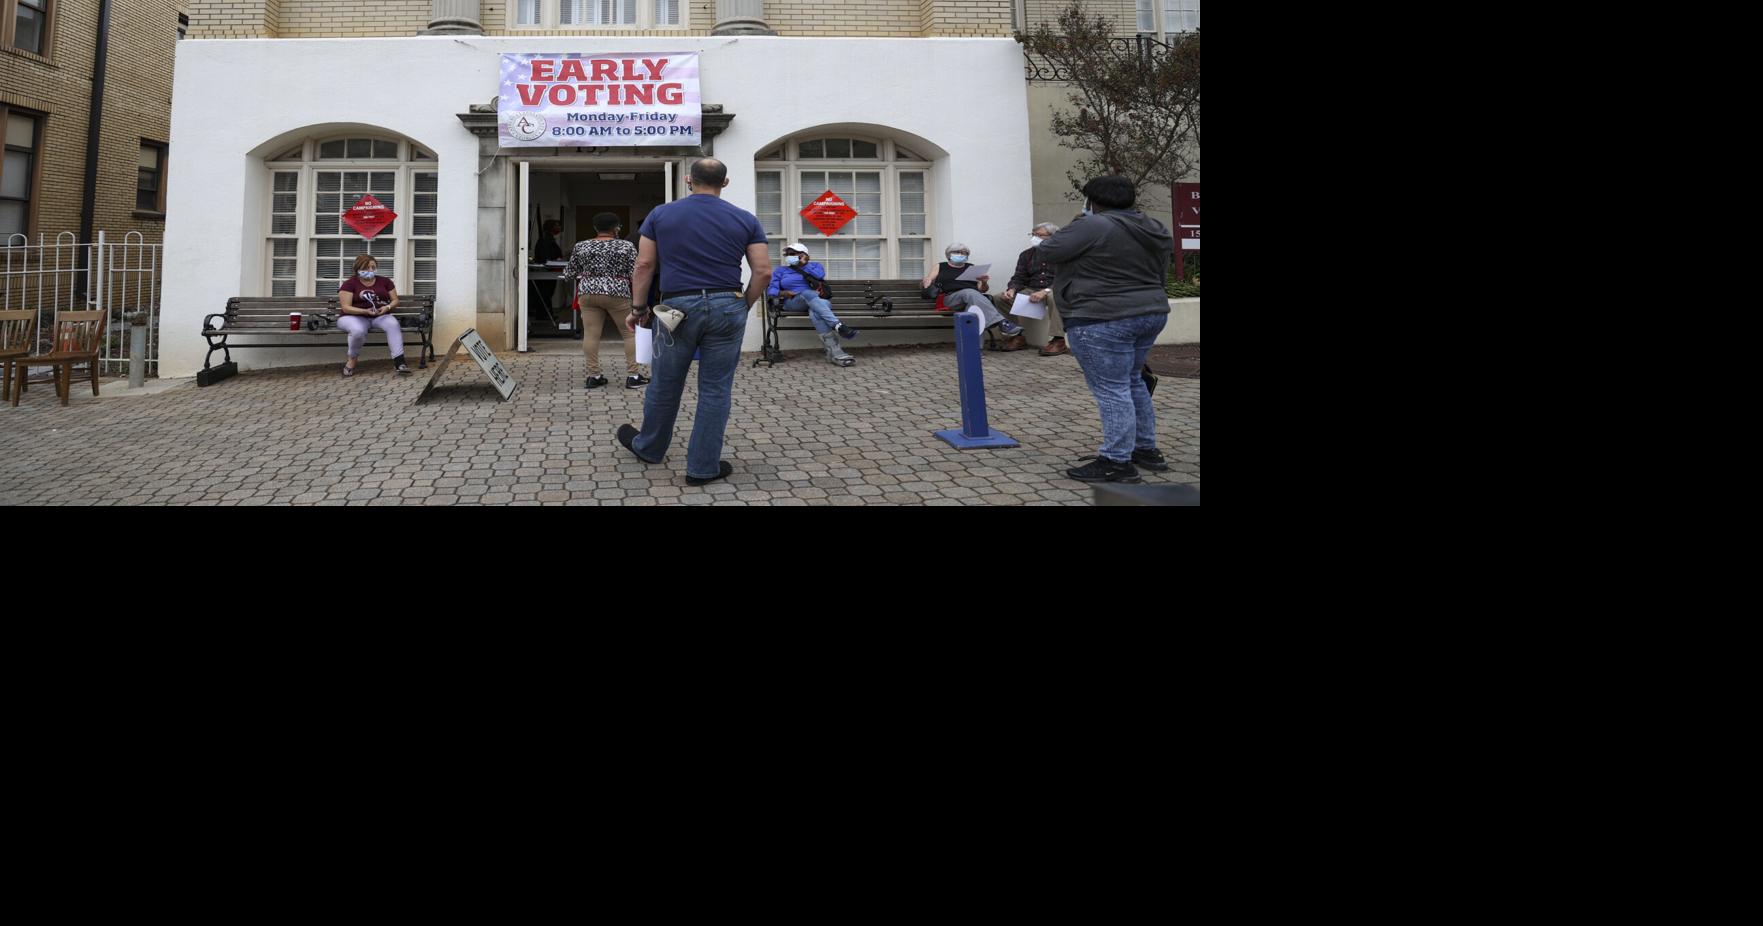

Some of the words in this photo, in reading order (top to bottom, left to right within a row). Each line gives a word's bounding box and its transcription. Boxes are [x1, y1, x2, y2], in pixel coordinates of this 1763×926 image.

[530, 58, 669, 82] EARLY
[516, 82, 684, 106] VOTING
[566, 112, 677, 123] Monday-Friday
[552, 126, 585, 136] 8:00
[589, 126, 612, 136] AM
[616, 126, 631, 136] to
[634, 125, 666, 136] 5:00
[669, 125, 693, 135] PM
[471, 340, 491, 363] VOTE
[489, 362, 509, 388] HERE
